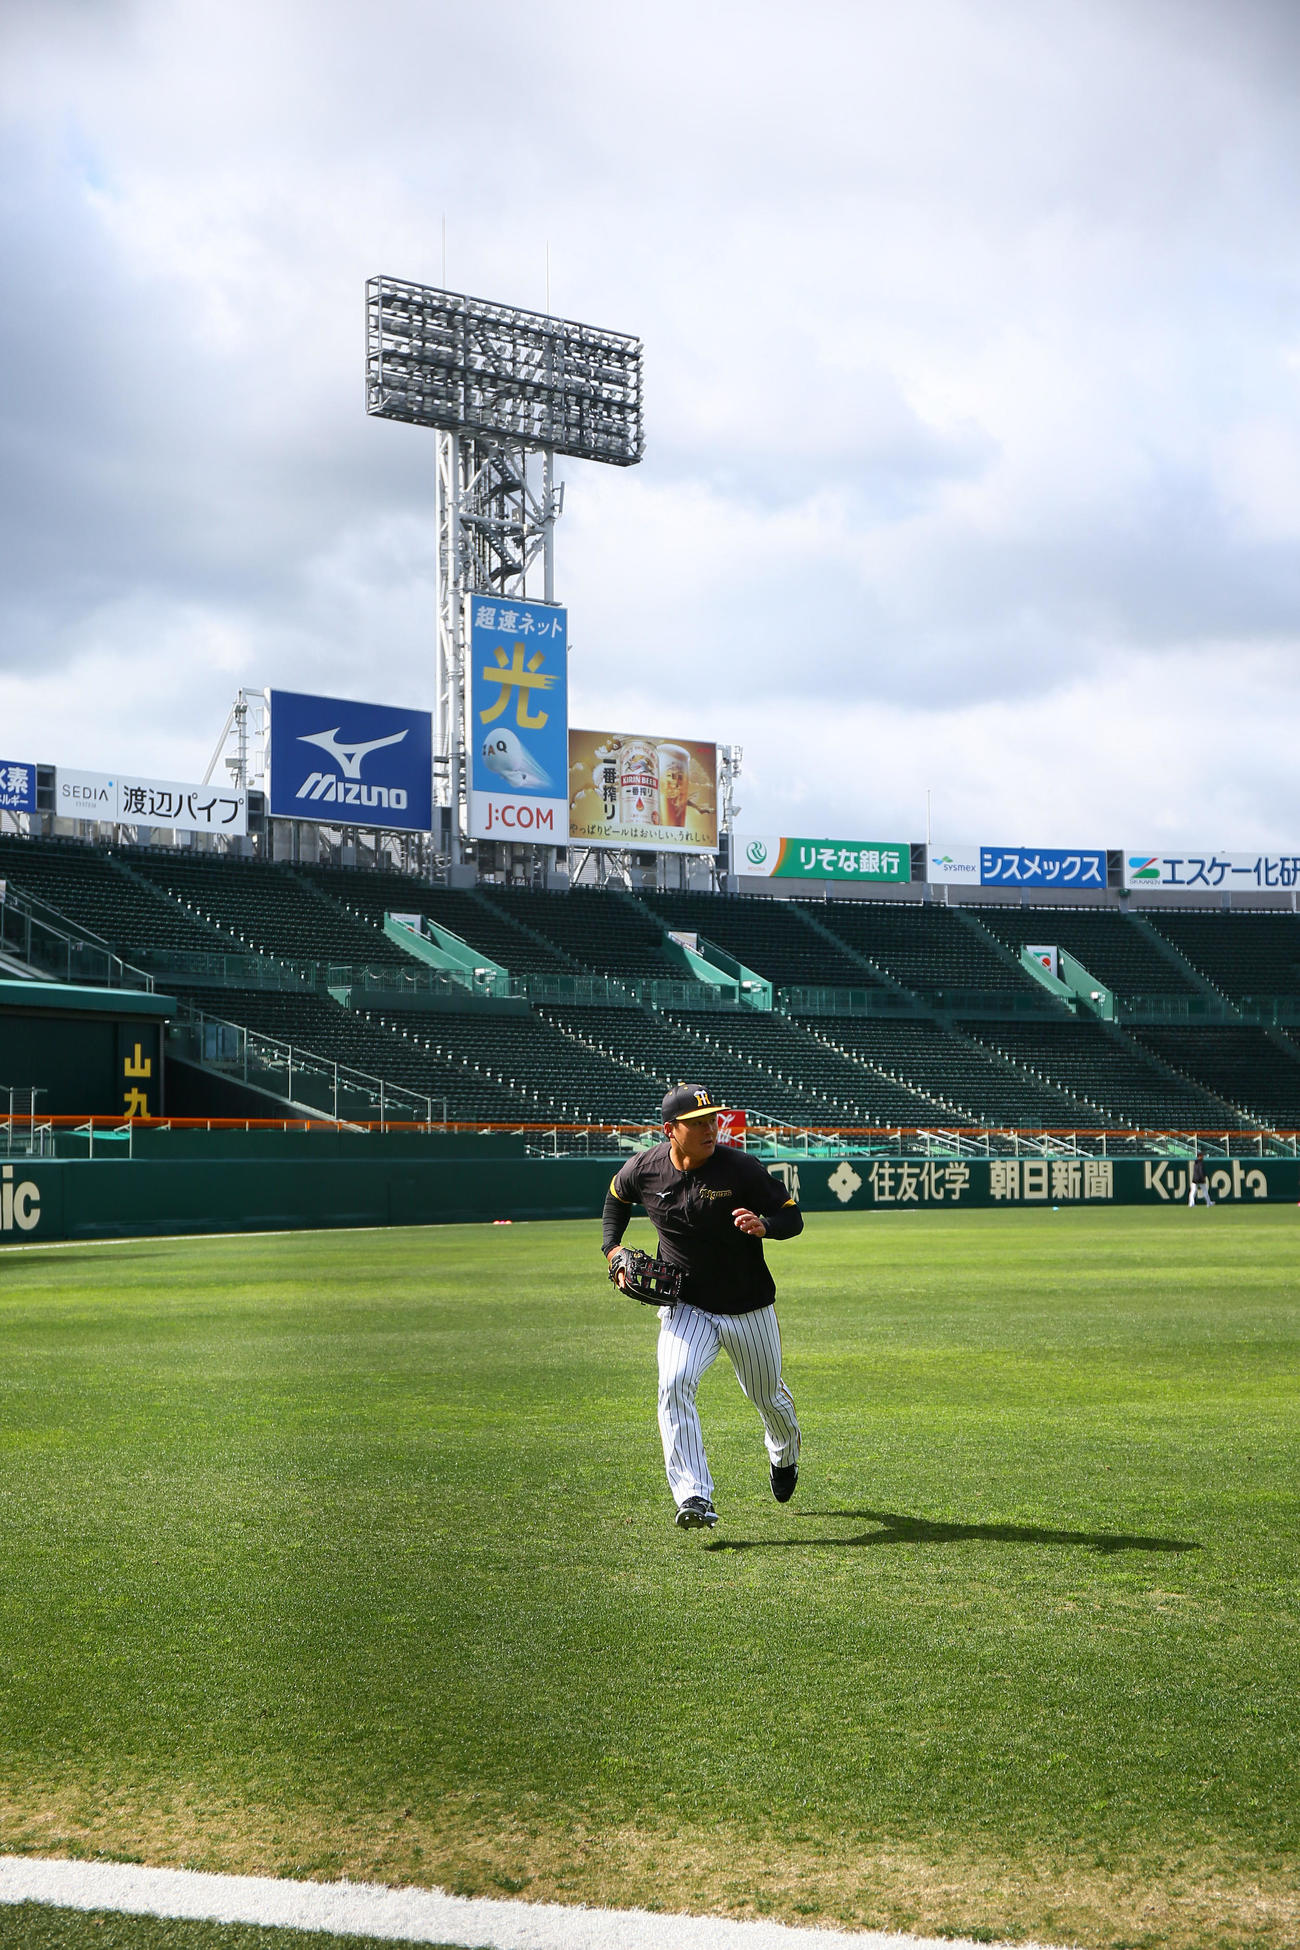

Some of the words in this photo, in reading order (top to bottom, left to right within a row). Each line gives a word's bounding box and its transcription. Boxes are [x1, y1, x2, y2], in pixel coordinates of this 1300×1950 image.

[475, 606, 563, 639] 超速ネット
[479, 642, 560, 729] 光
[0, 793, 28, 807] ルギー
[123, 786, 245, 824] 渡辺パイプ
[602, 758, 617, 820] 一番搾り
[485, 803, 553, 831] J:COM
[800, 846, 900, 874] りそな銀行
[943, 863, 977, 873] sysmex
[983, 853, 1103, 882] シスメックス
[1162, 856, 1300, 887] エスケー化研
[124, 1043, 151, 1120] 山九
[0, 1165, 40, 1230] ic
[868, 1161, 970, 1202] 住友化学
[990, 1160, 1114, 1200] 朝日新聞
